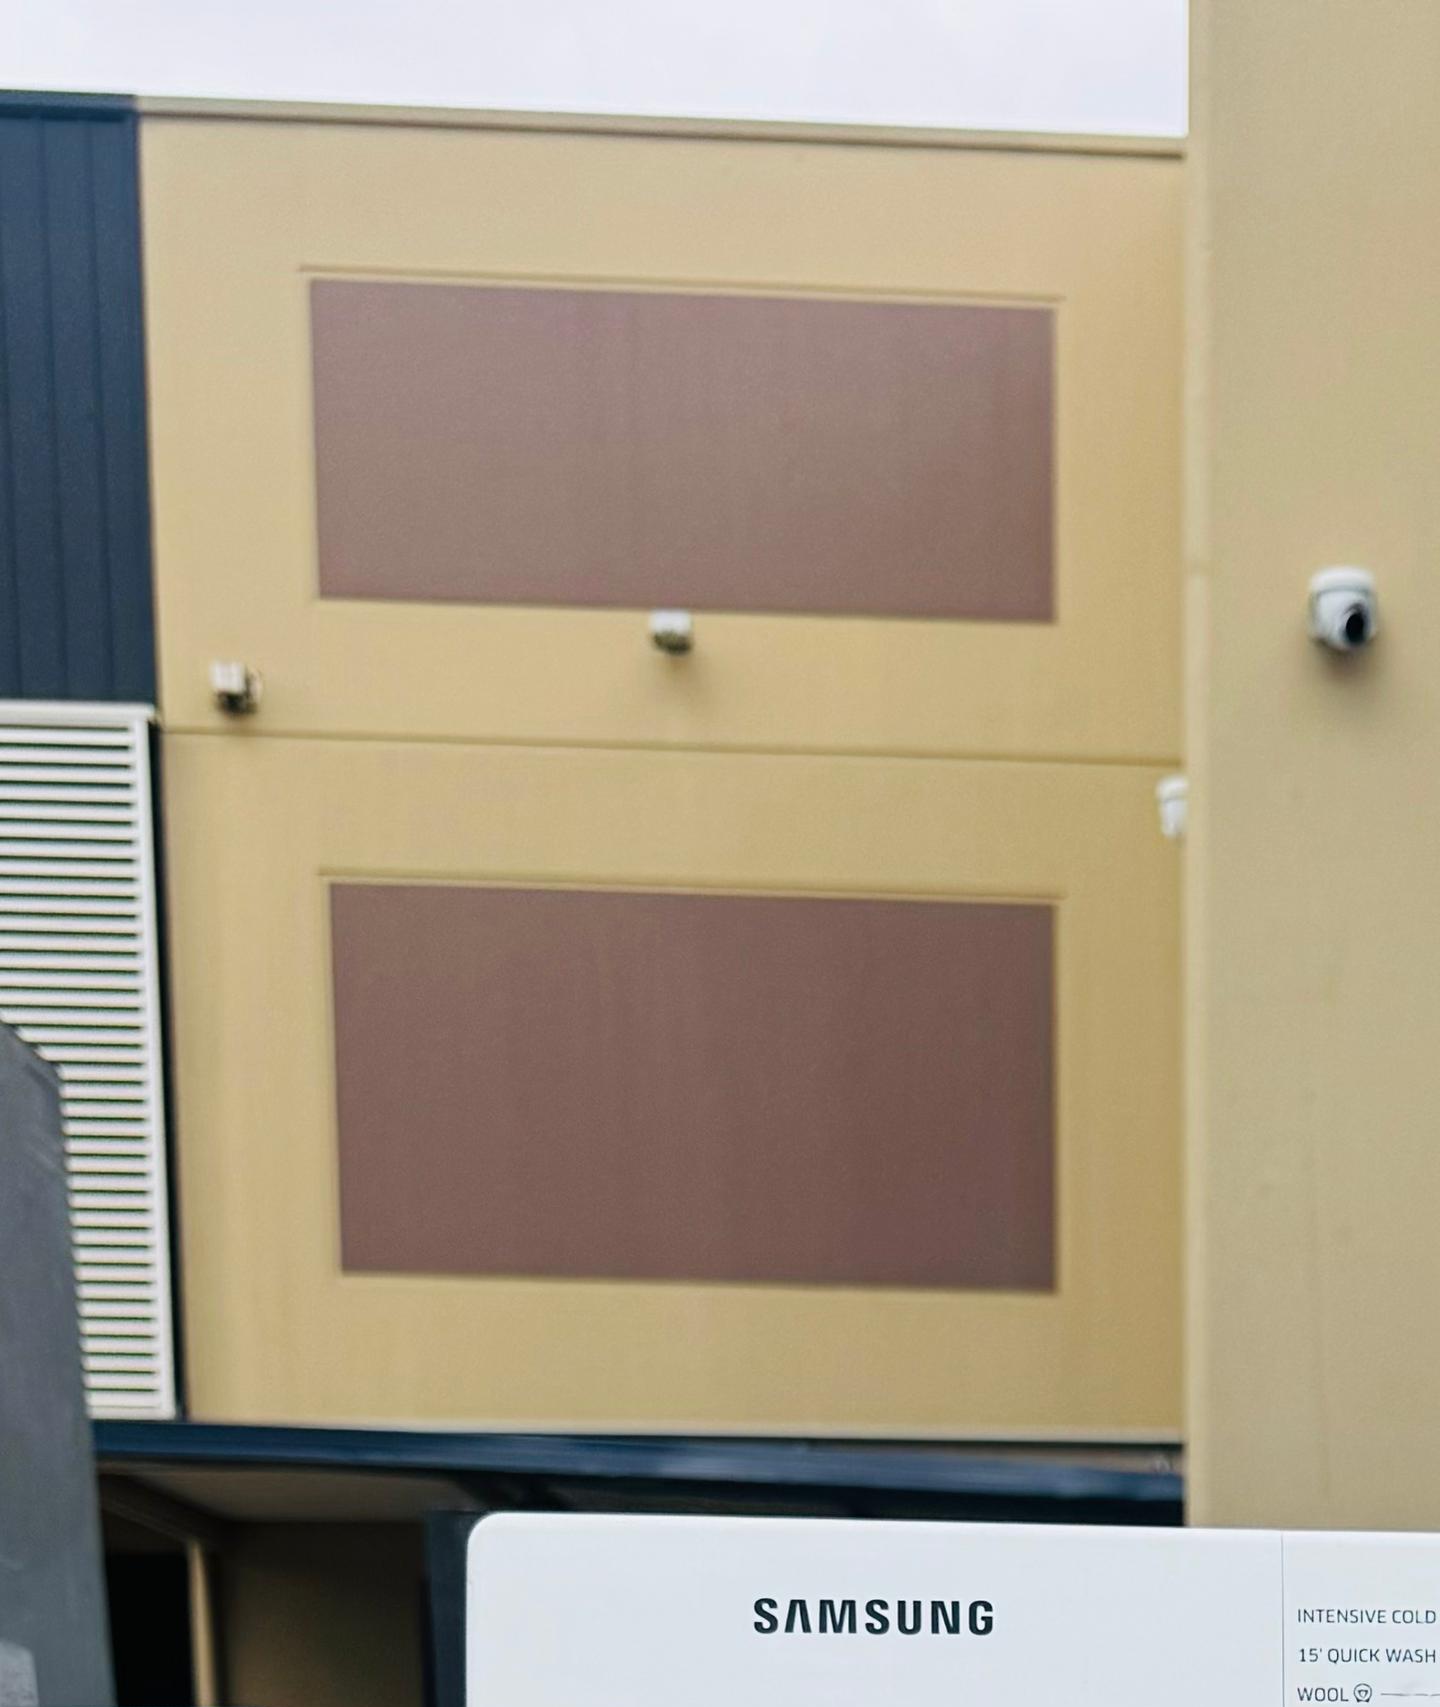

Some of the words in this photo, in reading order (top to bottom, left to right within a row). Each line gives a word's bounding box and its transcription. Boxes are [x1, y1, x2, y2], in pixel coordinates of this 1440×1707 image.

[753, 1597, 995, 1637] SAMSUNG
[1298, 1609, 1386, 1624] INTENSIVE
[1390, 1609, 1437, 1625] COLD
[1327, 1648, 1380, 1665] QUICK
[1384, 1648, 1437, 1664] WASH
[1297, 1687, 1349, 1702] WOOL
